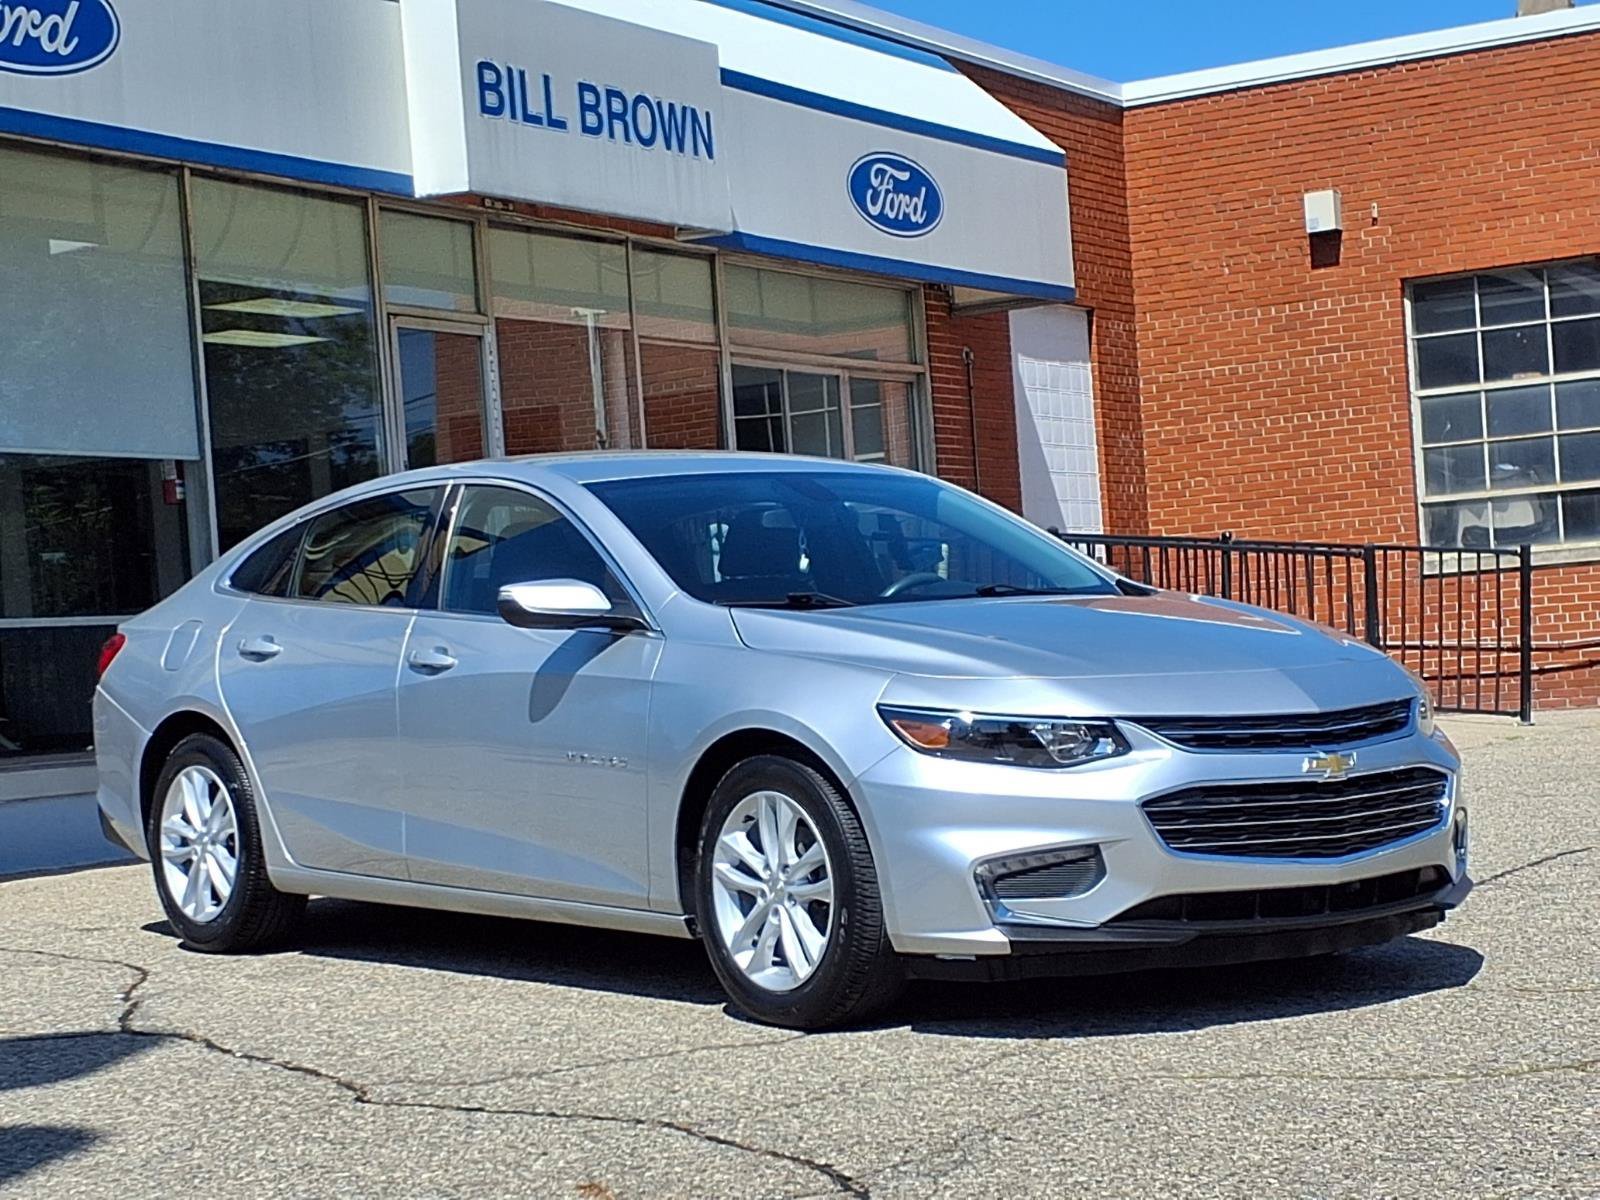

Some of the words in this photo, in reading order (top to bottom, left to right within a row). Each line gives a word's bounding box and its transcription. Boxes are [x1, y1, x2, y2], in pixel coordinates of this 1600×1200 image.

[0, 0, 79, 56] rd
[477, 60, 567, 131] BILL
[577, 81, 714, 160] BROWN
[866, 163, 927, 224] Ford
